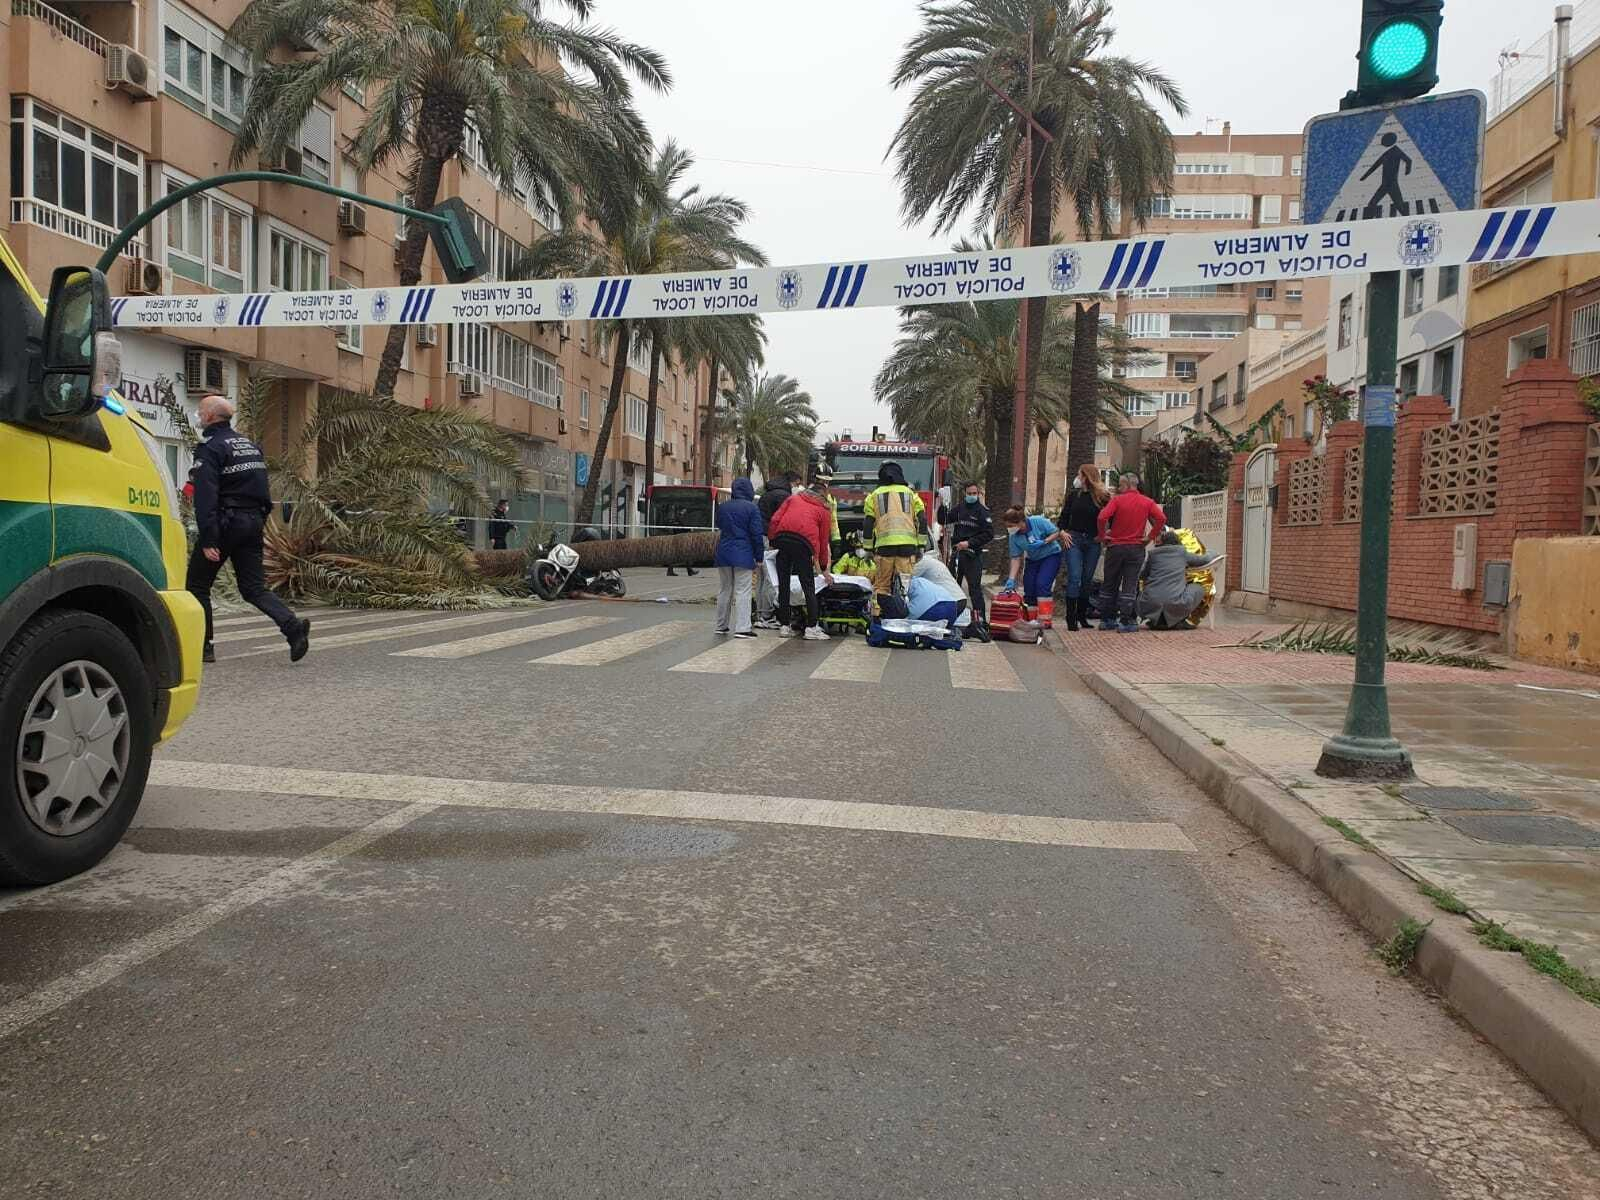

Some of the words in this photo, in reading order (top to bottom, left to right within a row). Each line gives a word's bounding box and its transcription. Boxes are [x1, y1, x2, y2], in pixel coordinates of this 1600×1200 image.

[1214, 234, 1308, 256] ALMERIA
[1322, 230, 1351, 248] DE
[906, 260, 979, 278] ALMERIA
[989, 257, 1012, 272] DE
[1198, 260, 1265, 278] LOCAL
[662, 278, 722, 293] ALMERIA
[729, 276, 748, 290] DE
[894, 282, 946, 298] LOCAL
[339, 294, 353, 306] DE
[461, 288, 510, 301] ALMERIA
[517, 288, 532, 299] DE
[186, 298, 199, 309] DE
[652, 297, 696, 311] LOCAL
[136, 312, 164, 322] LOCAL
[282, 310, 314, 321] LOCAL
[452, 305, 488, 317] LOCAL
[128, 487, 160, 508] D-1120
